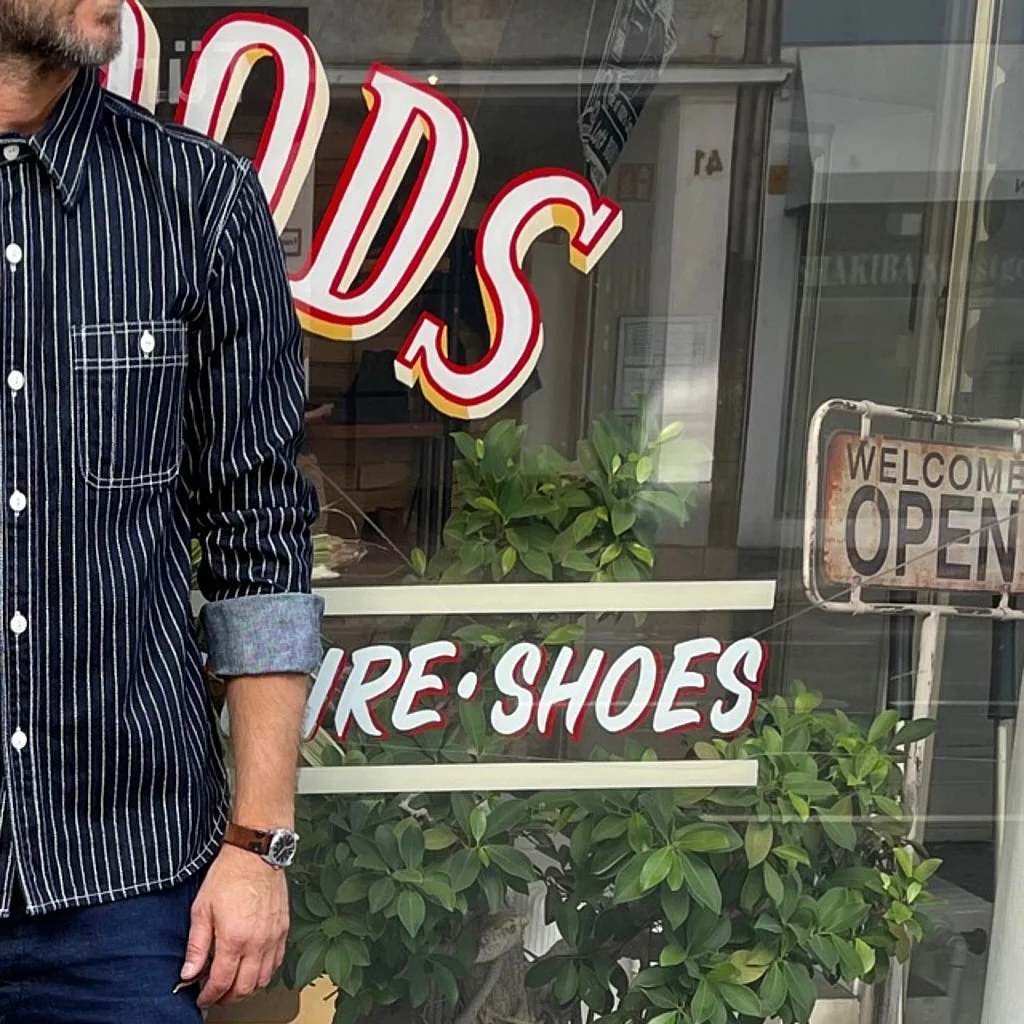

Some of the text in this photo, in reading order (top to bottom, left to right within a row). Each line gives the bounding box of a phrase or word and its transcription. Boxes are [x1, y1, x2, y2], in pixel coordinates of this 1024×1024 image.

[847, 443, 1024, 495] WELCOME
[845, 484, 1021, 583] OPEN
[490, 637, 768, 741] SHOES
